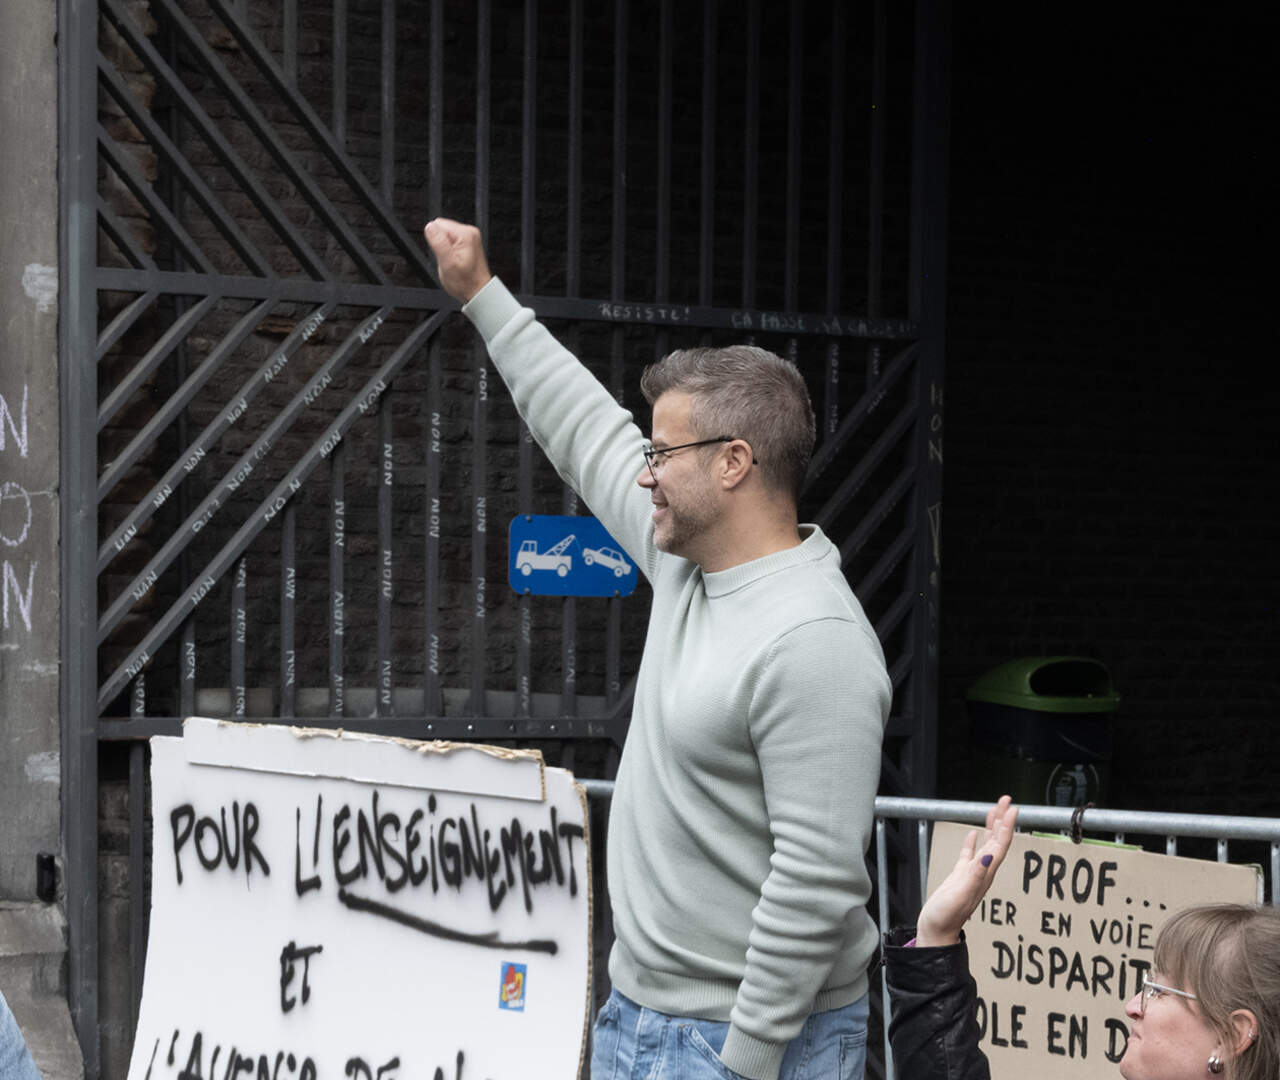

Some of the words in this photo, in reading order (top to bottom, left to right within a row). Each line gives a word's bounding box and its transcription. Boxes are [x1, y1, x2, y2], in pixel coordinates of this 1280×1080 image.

[302, 312, 325, 341] NON
[304, 373, 333, 405] NON
[357, 380, 387, 413] NON
[479, 368, 487, 400] NON
[227, 397, 249, 424] NON
[430, 413, 440, 453] NON
[227, 462, 253, 491] NON
[383, 444, 393, 486] NON
[335, 499, 345, 547] NON
[429, 499, 440, 538] NON
[477, 497, 486, 533] NON
[192, 576, 216, 605] NON
[382, 551, 393, 601] NON
[334, 592, 344, 635] NON
[476, 577, 486, 618] NON
[237, 609, 246, 643] NON
[125, 650, 151, 678] NON
[186, 642, 196, 680] NON
[429, 634, 439, 674] NON
[381, 660, 391, 704] NON
[170, 801, 270, 886] POUR
[981, 898, 1017, 927] IER
[1040, 911, 1071, 937] EN
[280, 941, 323, 1014] ET
[991, 934, 1152, 1001] DISPARIT
[975, 997, 1028, 1050] OLE
[1047, 1012, 1088, 1059] EN
[1104, 1018, 1130, 1064] D
